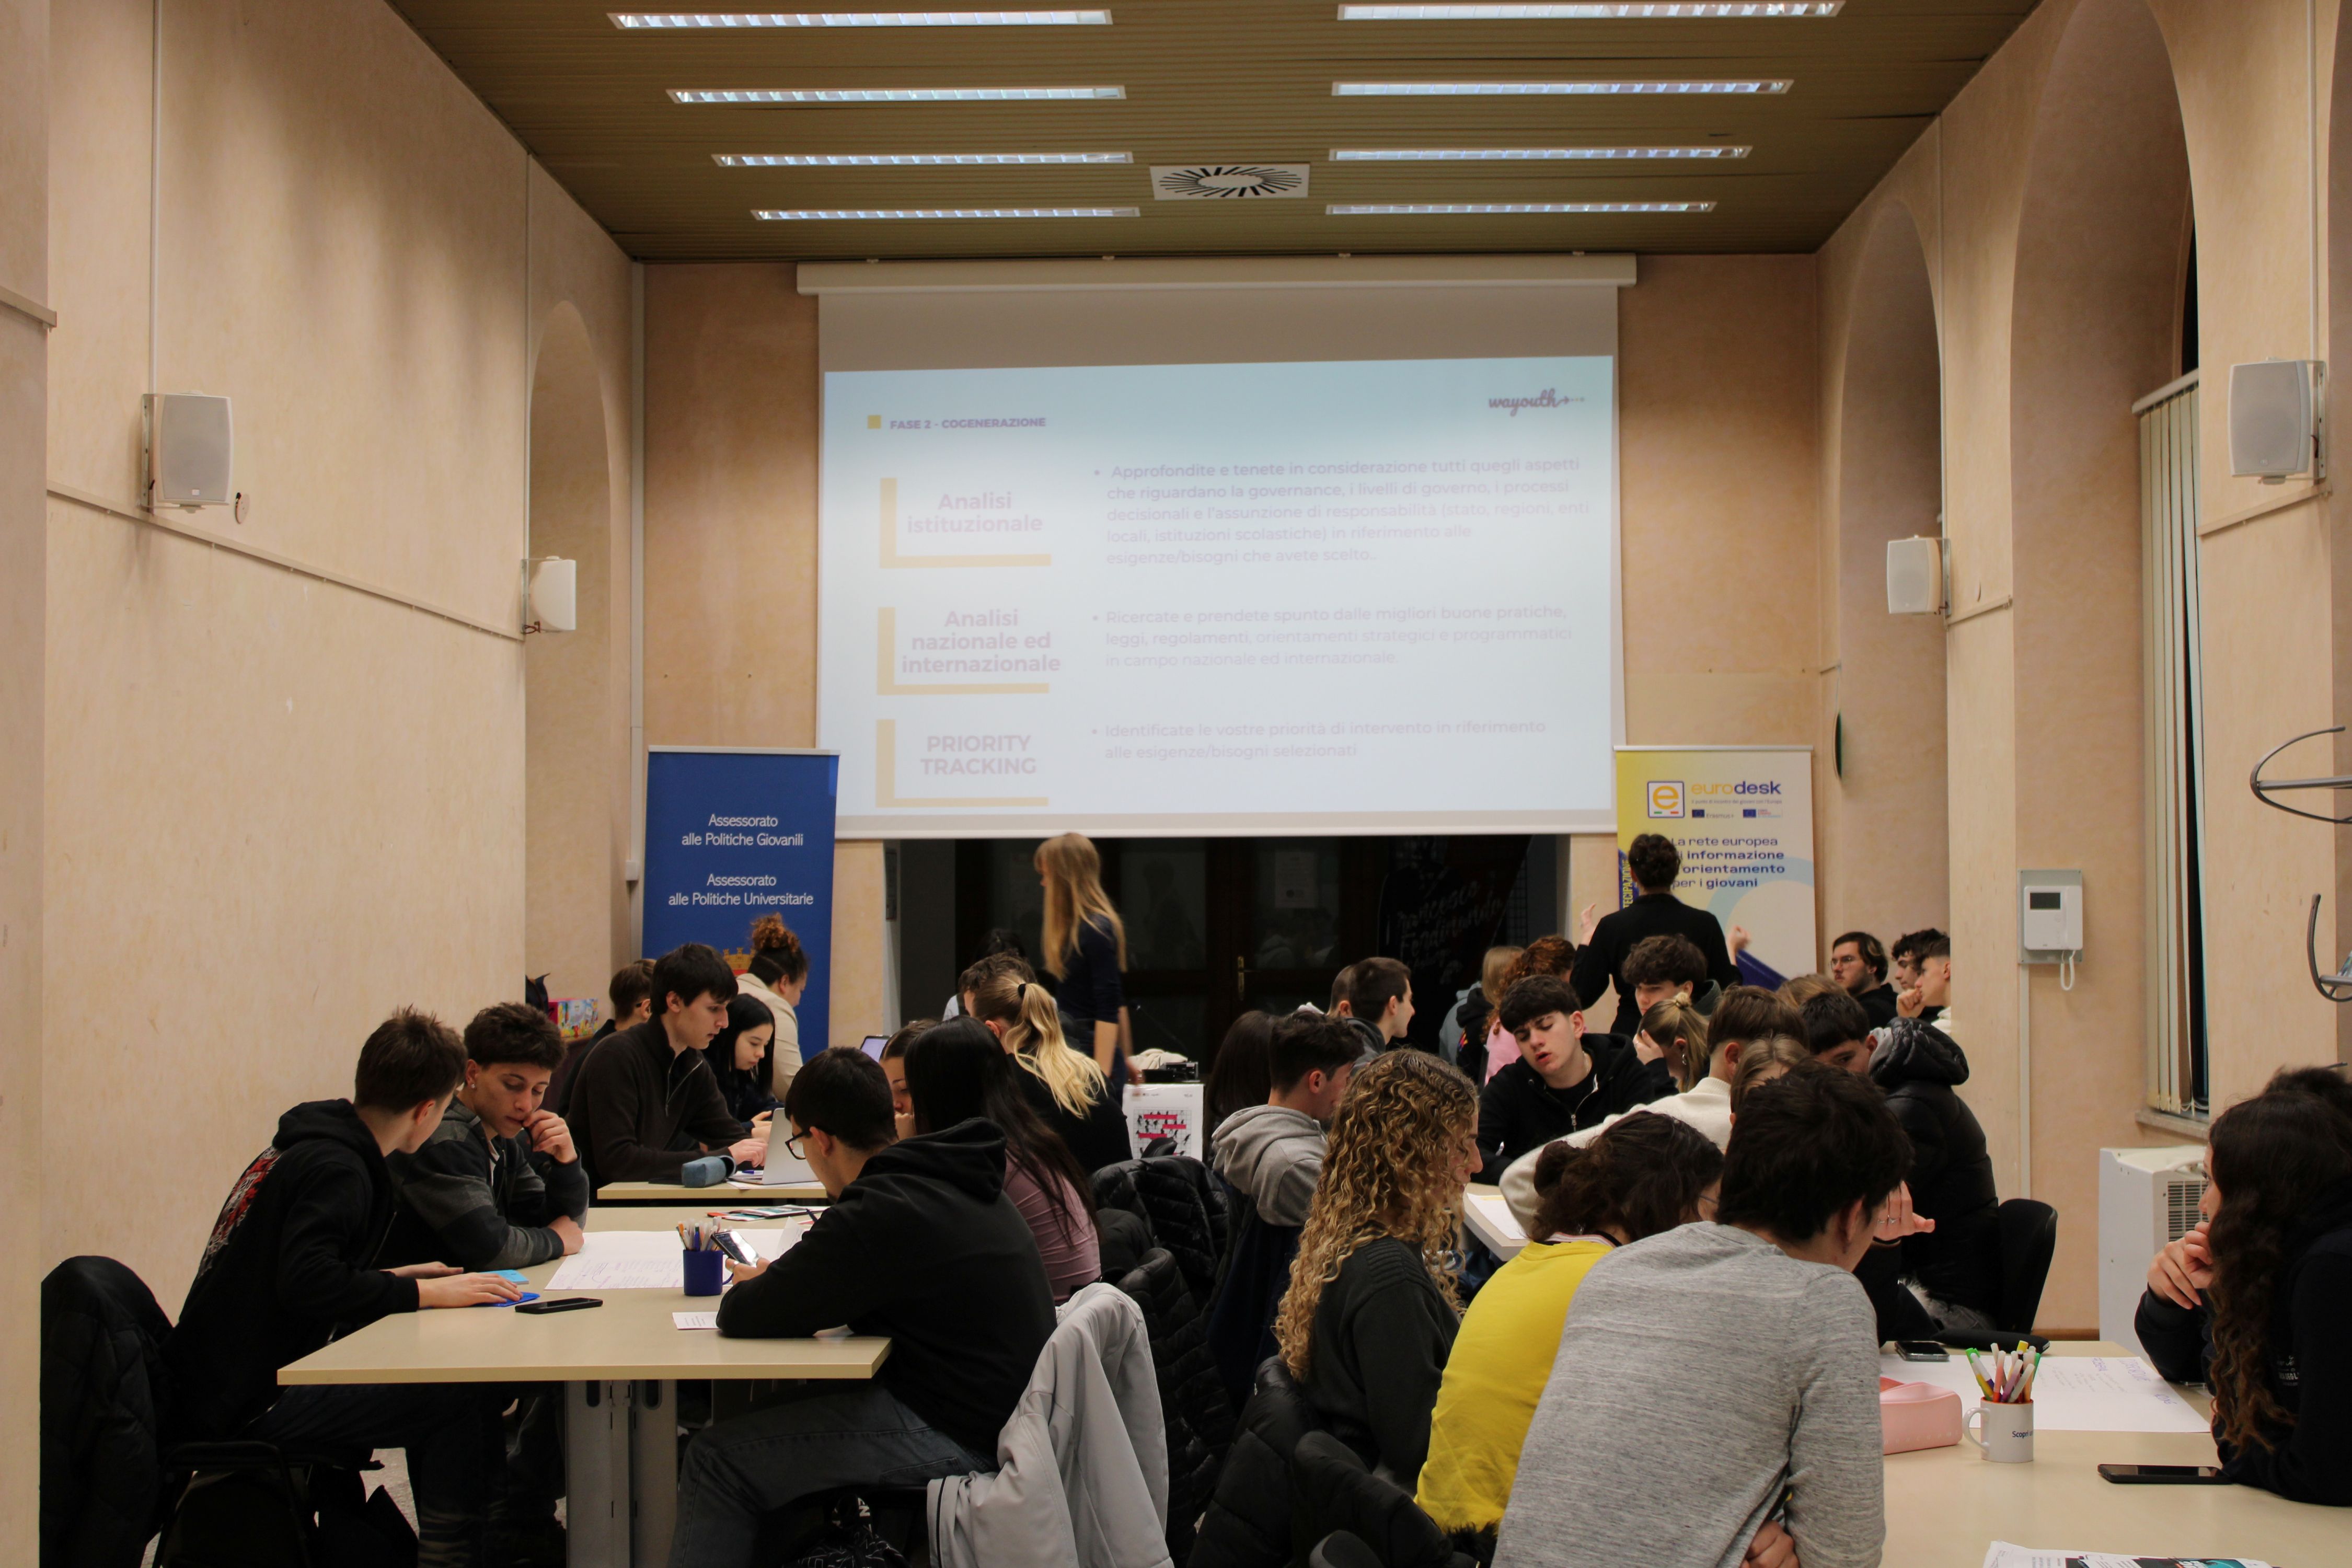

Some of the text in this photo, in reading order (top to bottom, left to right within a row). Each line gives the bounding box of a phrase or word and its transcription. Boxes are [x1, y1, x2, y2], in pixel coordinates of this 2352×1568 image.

[1489, 388, 1559, 417] wayouth
[890, 420, 921, 429] FASE
[924, 420, 931, 429] 2
[941, 418, 1046, 428] COGENERAZIONE
[1112, 460, 1579, 479] Approfondite e tenete in considerazione tutti quegli aspetti
[1107, 479, 1569, 501] che riguardano la governance, i livelli di governo, i processi
[938, 491, 1012, 510] Analisi
[1107, 501, 1589, 521] decisionali e l'assunzione di responsabilità (stato, regioni, enti
[908, 515, 1043, 533] istituzionale
[1107, 526, 1471, 543] locali, istituzioni scolastiche) in riferimento alle
[1106, 550, 1238, 566] esigenze/bisogni
[1242, 550, 1271, 562] che
[1276, 551, 1319, 561] avete
[944, 609, 1018, 627] Analisi
[1106, 606, 1566, 624] Ricercate e prendete spunto dalle migliori buone pratiche,
[912, 632, 1051, 650] nazionale ed
[1106, 629, 1572, 648] leggi, regolamenti, orientamenti strategici e programmatici
[902, 654, 1061, 672] internazionale
[1106, 652, 1399, 668] in campo nazionale ed internazionale.
[1105, 721, 1546, 737] Identificate le vostre priorità di intervento in riferimento
[927, 735, 1031, 752] PRIORITY
[1105, 744, 1356, 760] alle esigenze/bisogni selezionati
[920, 758, 1036, 774] TRACKING
[1691, 781, 1781, 794] eurodesk
[708, 814, 778, 826] Assessorato
[682, 832, 803, 845] alle Politiche Giovanili
[1722, 839, 1778, 847] europea
[707, 873, 777, 886] Assessorato
[1673, 878, 1758, 890] per i giovani
[668, 892, 814, 905] alle Politiche Universitarie
